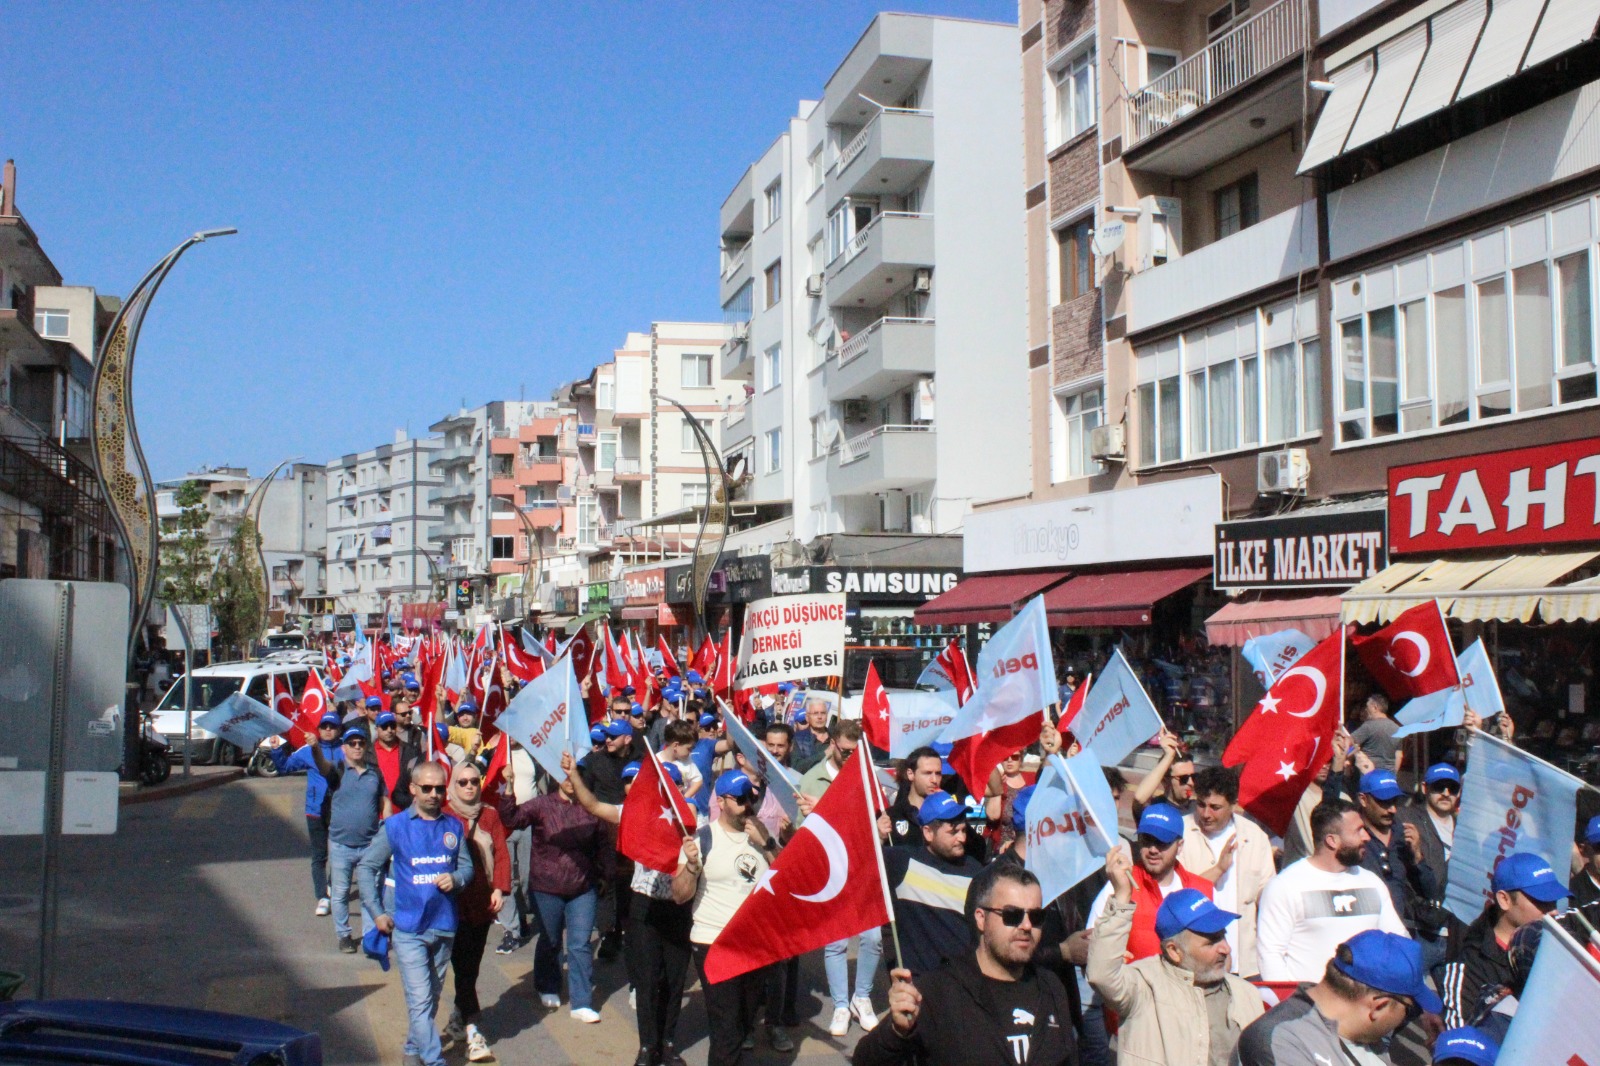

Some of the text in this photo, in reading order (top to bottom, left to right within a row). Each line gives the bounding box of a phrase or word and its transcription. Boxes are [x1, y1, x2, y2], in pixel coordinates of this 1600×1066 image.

[1219, 530, 1381, 582] İLKE MARKET
[826, 572, 958, 593] SAMSUNG
[783, 602, 843, 625] DÜŞÜNCE
[752, 629, 802, 654] DERNEĞİ
[783, 650, 838, 673] ŞUBESİ
[413, 872, 440, 885] SEND
